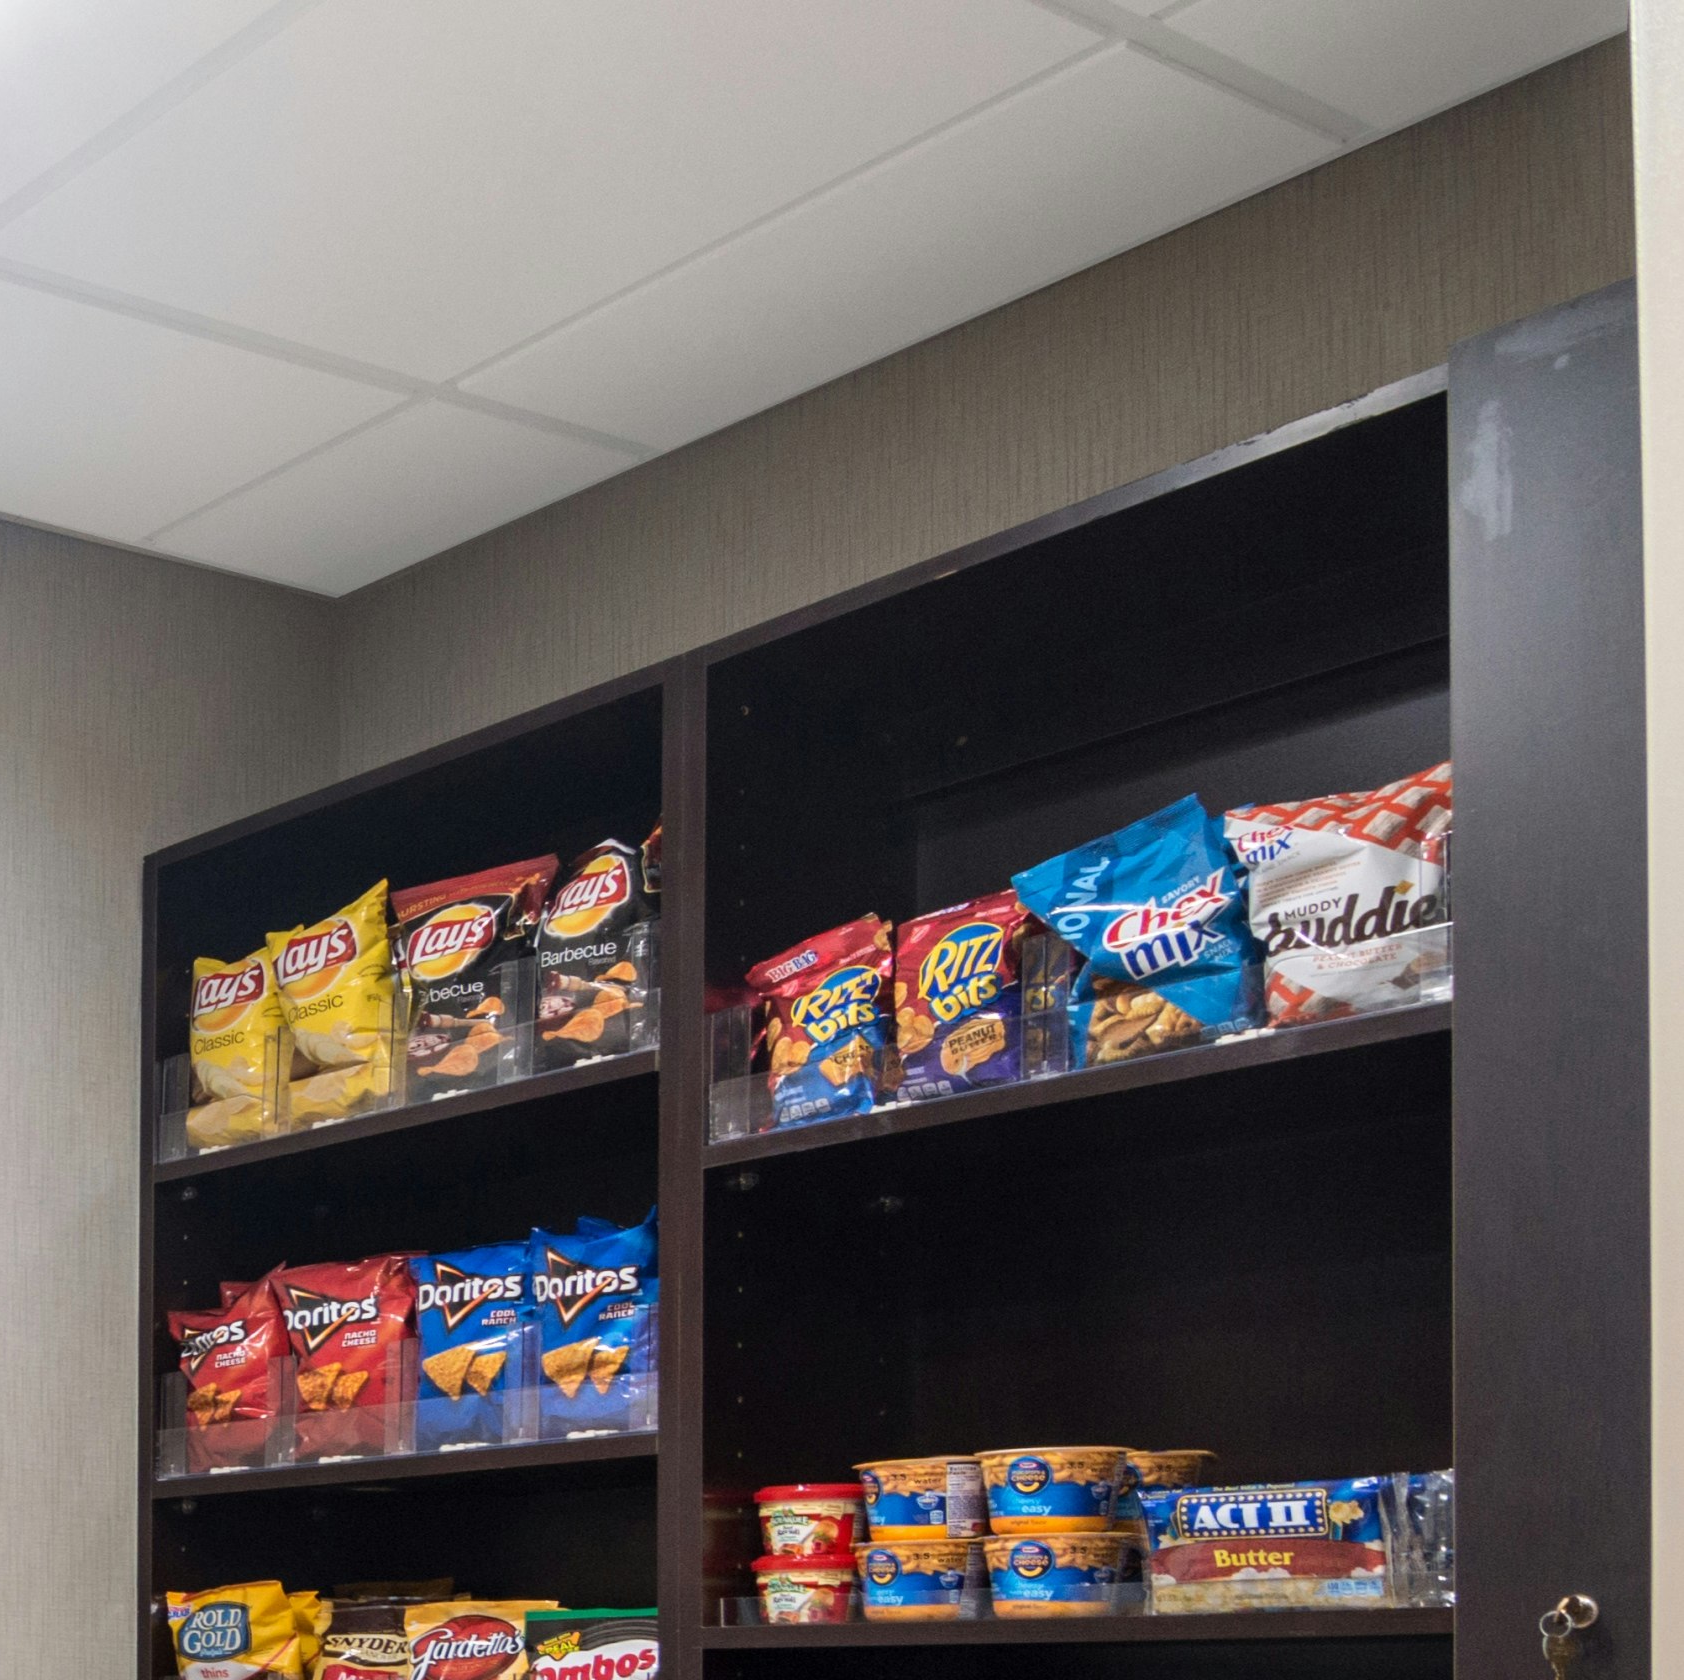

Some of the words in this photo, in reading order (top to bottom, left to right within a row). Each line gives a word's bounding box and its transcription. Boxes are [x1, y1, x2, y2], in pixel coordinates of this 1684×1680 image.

[552, 868, 622, 920] Lay's
[1162, 876, 1201, 903] SAVORY
[1104, 872, 1225, 950] Chex
[1284, 897, 1342, 921] MUDDY
[411, 914, 492, 965] Lay's
[1125, 904, 1226, 978] mix
[277, 928, 349, 985] Lay's
[541, 942, 617, 968] Barbecue
[919, 931, 1003, 998] RITZ
[194, 967, 260, 1018] Lay's
[792, 969, 878, 1026] RITZ
[932, 974, 998, 1023] bits
[288, 994, 344, 1024] Classic
[809, 1002, 877, 1042] bits
[194, 1031, 245, 1055] Classic
[948, 1025, 996, 1048] PEANUT
[419, 1275, 522, 1311] Doritos
[536, 1267, 638, 1302] Doritos
[482, 1316, 517, 1326] RANCH
[491, 1309, 517, 1318] COOL
[598, 1309, 635, 1321] RANCH
[342, 1336, 377, 1348] CHEESE
[344, 1329, 377, 1340] NACHO
[215, 1357, 246, 1368] CHEESE
[216, 1349, 246, 1362] NACHO
[1022, 1504, 1052, 1515] easy
[1193, 1502, 1261, 1530] ACT
[1269, 1500, 1311, 1527] II
[1213, 1549, 1294, 1568] Butter
[877, 1594, 904, 1605] easy
[1027, 1590, 1054, 1600] easy
[192, 1608, 242, 1630] ROLD
[183, 1628, 241, 1654] GOLD
[200, 1667, 229, 1678] thins
